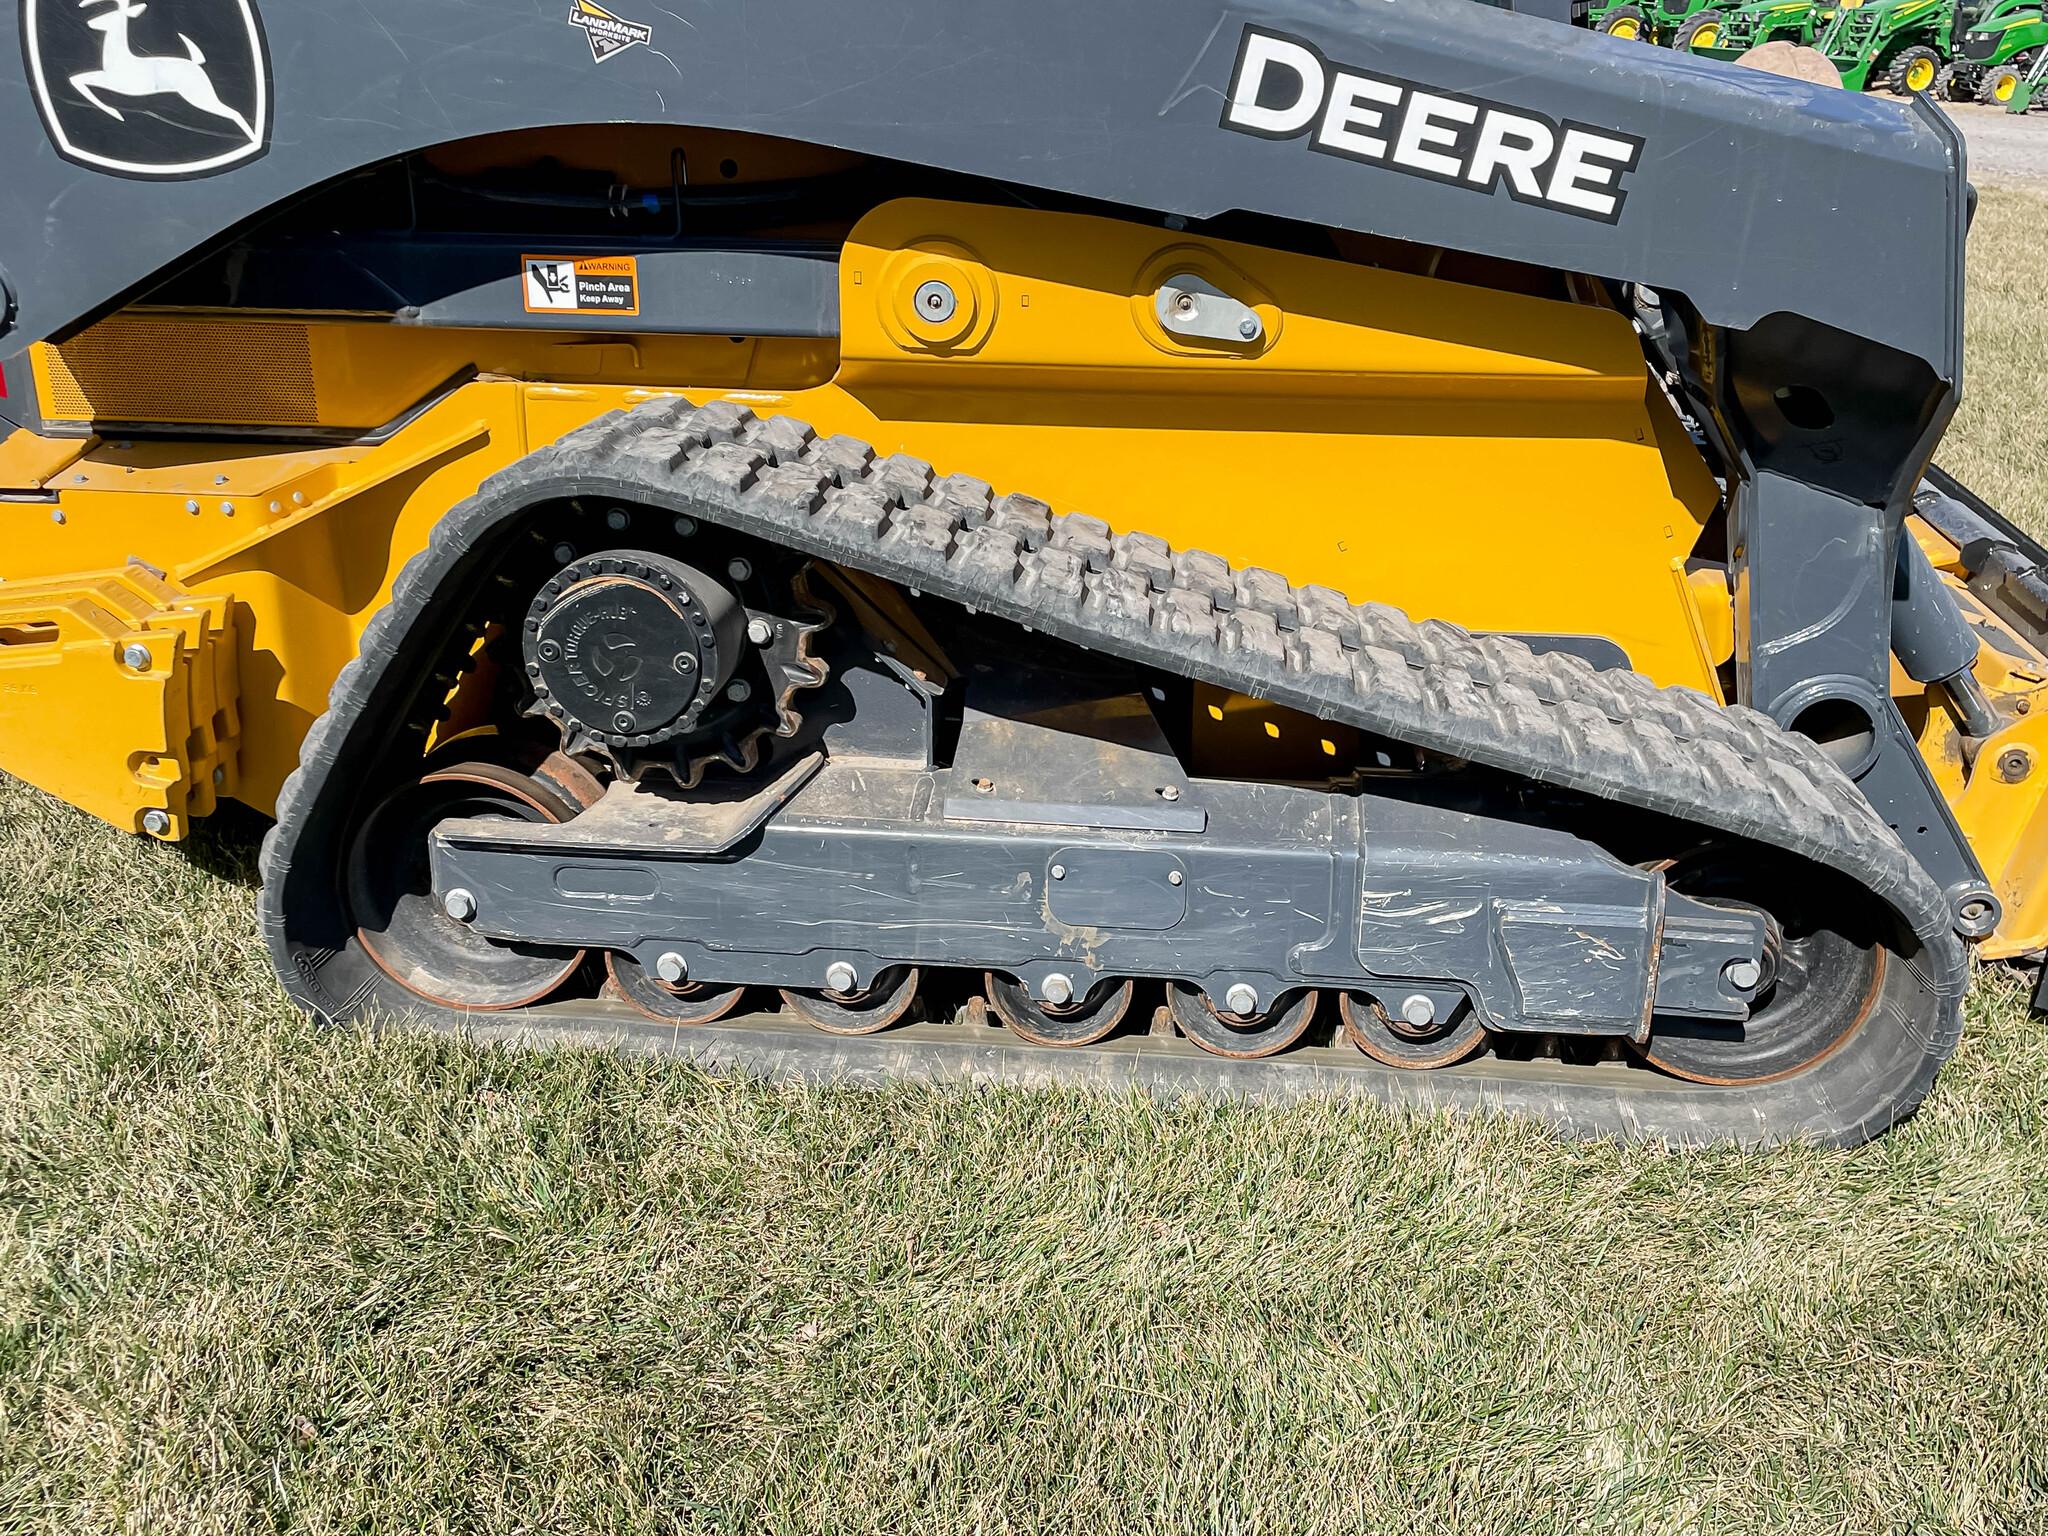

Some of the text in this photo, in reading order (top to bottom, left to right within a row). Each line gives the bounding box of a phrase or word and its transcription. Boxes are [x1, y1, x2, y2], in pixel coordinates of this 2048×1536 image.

[589, 27, 631, 43] WORKSITE
[1228, 32, 1635, 216] DEERE
[588, 262, 631, 271] WARNING
[578, 281, 631, 293] Pinch Area
[579, 294, 624, 305] Keep Away
